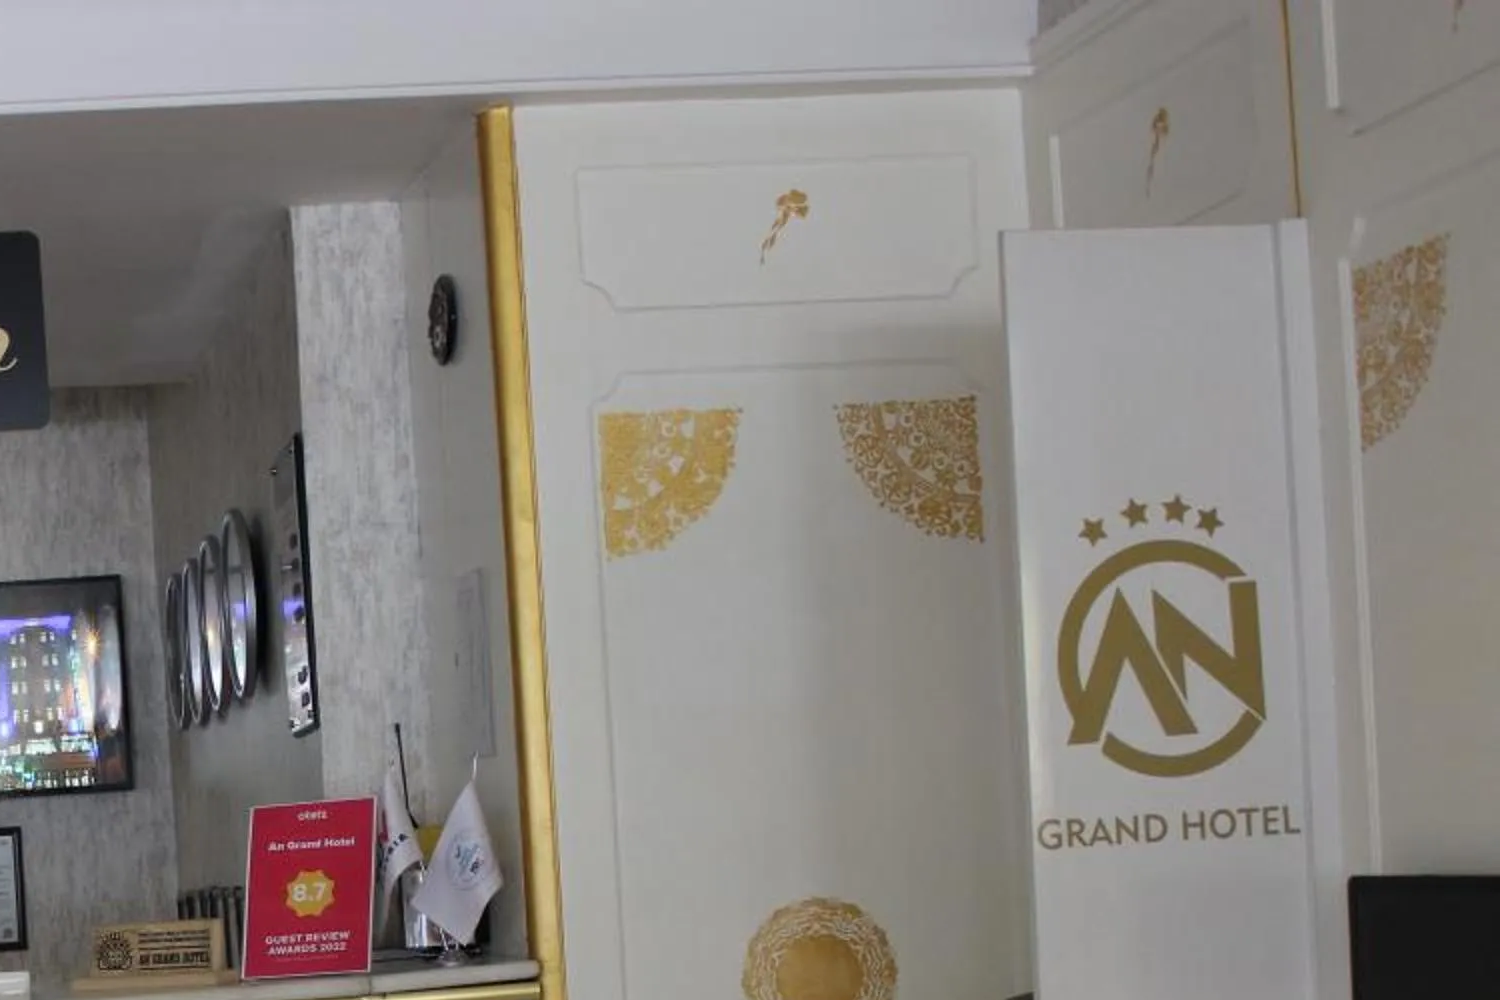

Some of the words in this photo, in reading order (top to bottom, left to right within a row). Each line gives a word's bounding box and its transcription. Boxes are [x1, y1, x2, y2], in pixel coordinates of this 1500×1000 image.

[1037, 811, 1168, 852] GRAND
[1181, 804, 1302, 840] HOTEL
[267, 840, 285, 851] An
[287, 838, 322, 850] Grand
[324, 836, 355, 848] Hotel
[292, 881, 327, 902] 8.7
[265, 934, 302, 945] GUEST
[305, 930, 351, 943] REVIEW
[268, 943, 318, 956] AWARDS
